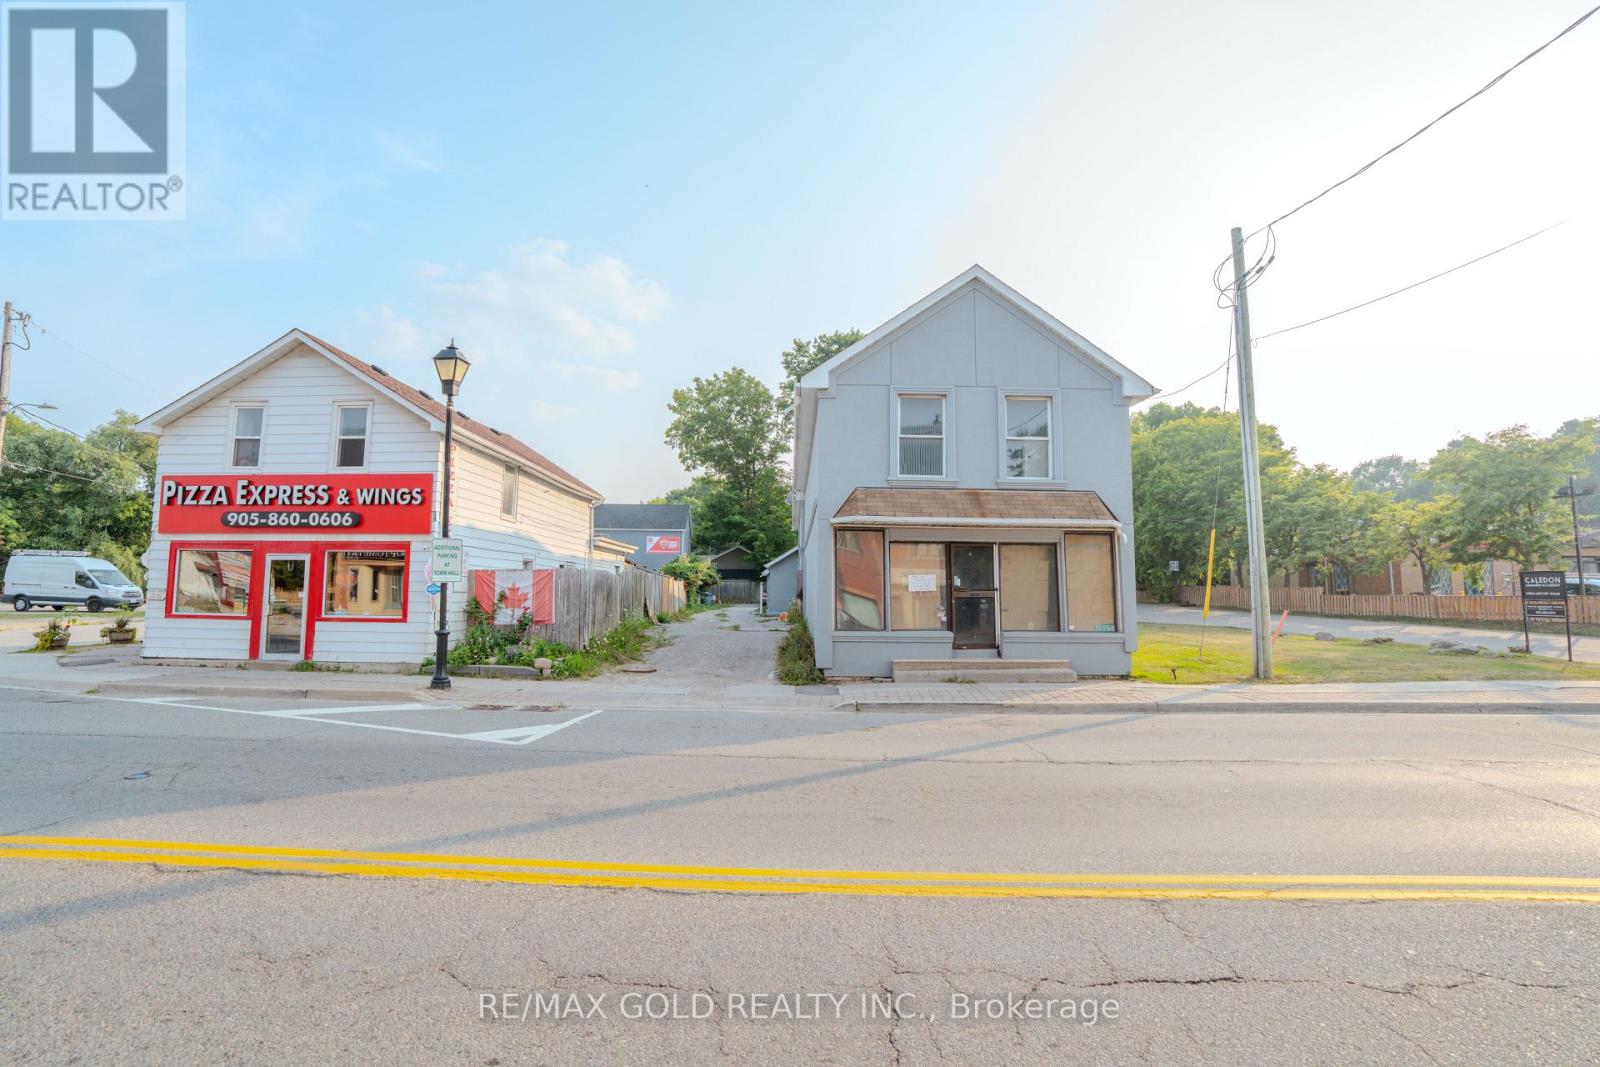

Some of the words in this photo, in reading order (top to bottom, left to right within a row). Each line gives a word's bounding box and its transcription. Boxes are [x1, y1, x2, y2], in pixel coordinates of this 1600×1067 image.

[162, 480, 229, 506] PIZZA
[236, 480, 330, 505] EXPRESS
[336, 488, 350, 505] &
[356, 487, 422, 505] WINGS
[226, 512, 353, 527] 905-860-0606
[1524, 576, 1561, 584] CALEDON
